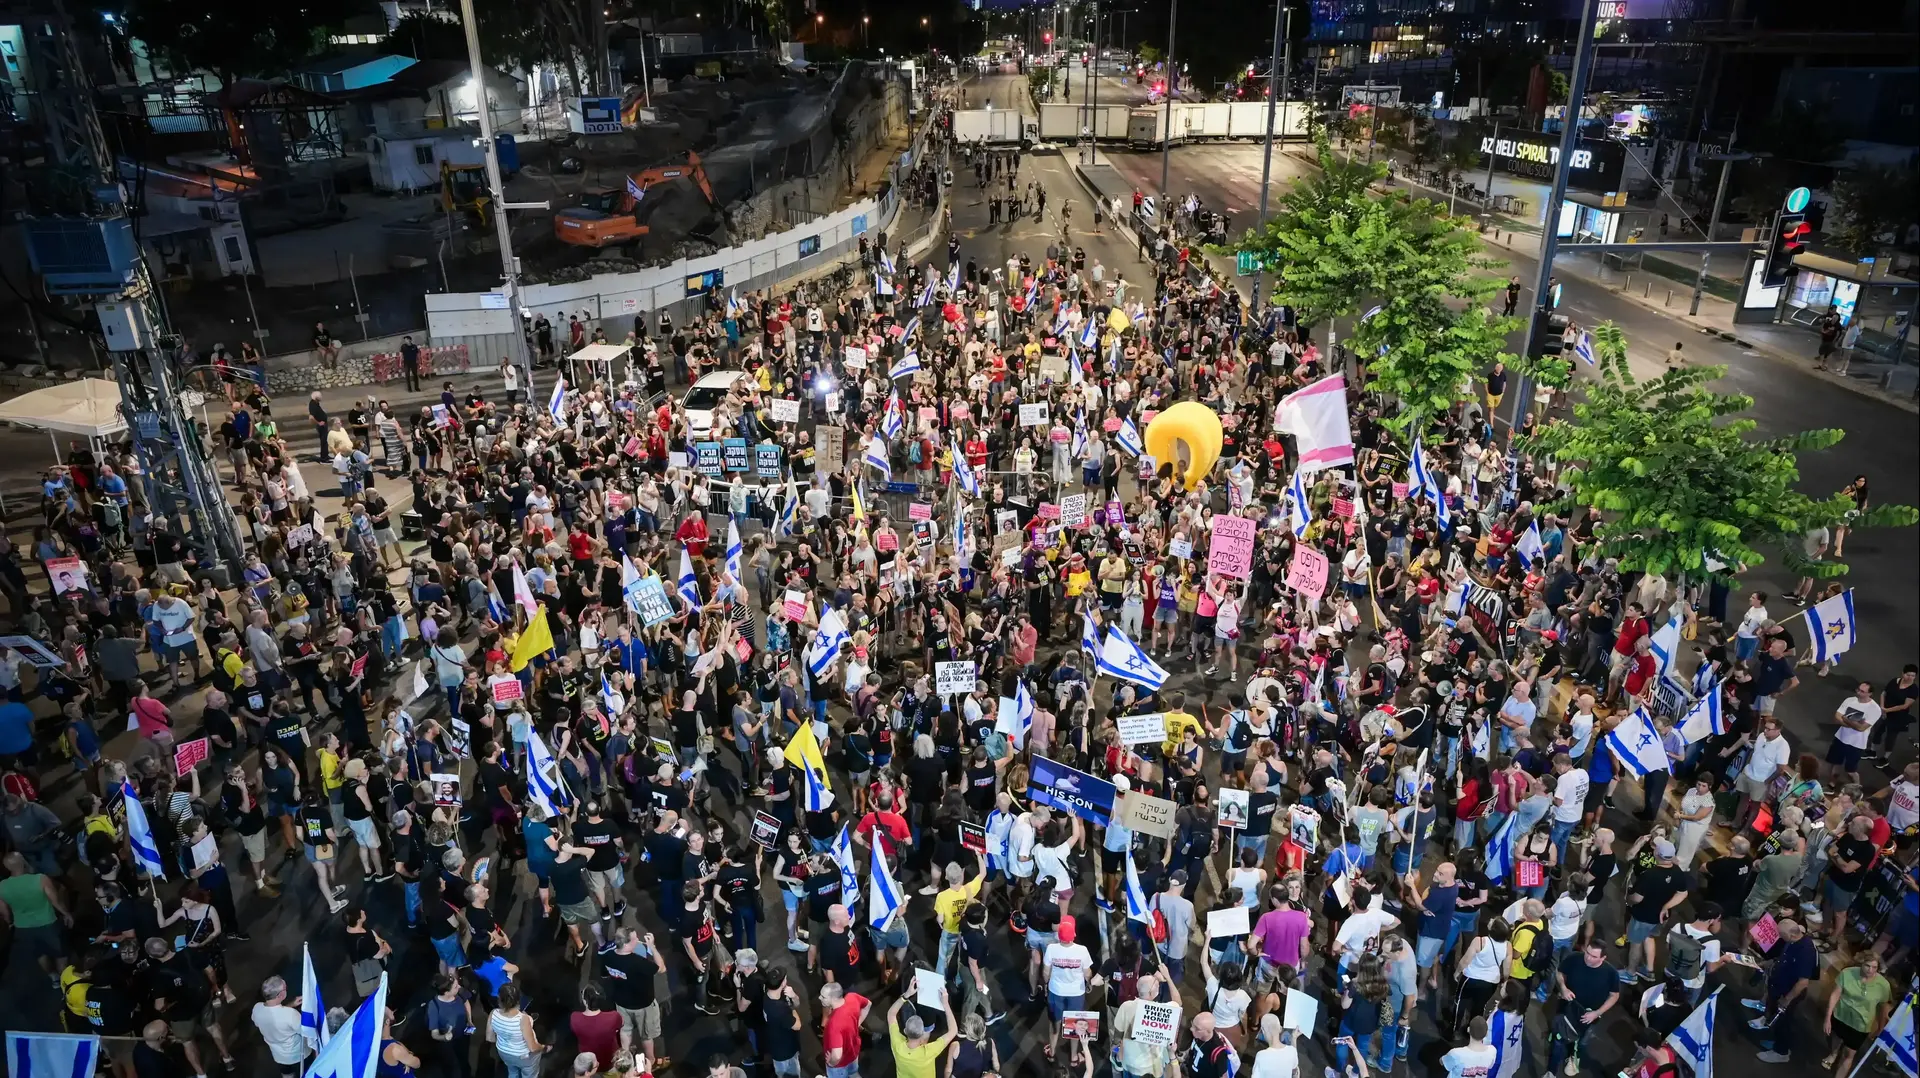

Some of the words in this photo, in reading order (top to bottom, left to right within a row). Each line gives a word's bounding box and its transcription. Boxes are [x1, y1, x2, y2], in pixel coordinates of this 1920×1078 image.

[1516, 142, 1548, 164] SPIRAL
[700, 457, 718, 465] עסקה
[1217, 518, 1249, 530] רשימת
[1234, 538, 1246, 546] דף
[1212, 551, 1243, 564] עסקת
[1211, 559, 1243, 573] חטופים
[634, 584, 661, 602] SEAL
[642, 594, 662, 610] THE
[642, 605, 671, 623] DEAL
[1046, 786, 1065, 800] HIS
[1068, 794, 1093, 810] SON
[1141, 803, 1168, 814] עסקה
[1135, 811, 1167, 825] עכשיו
[1757, 921, 1775, 944] DEMAND
[1763, 918, 1778, 938] WOMEN
[1758, 931, 1768, 944] LIFE
[1144, 1004, 1173, 1014] BRING
[1145, 1010, 1170, 1019] THEM
[1142, 1019, 1172, 1030] NOW!
[1144, 1015, 1169, 1024] HOME
